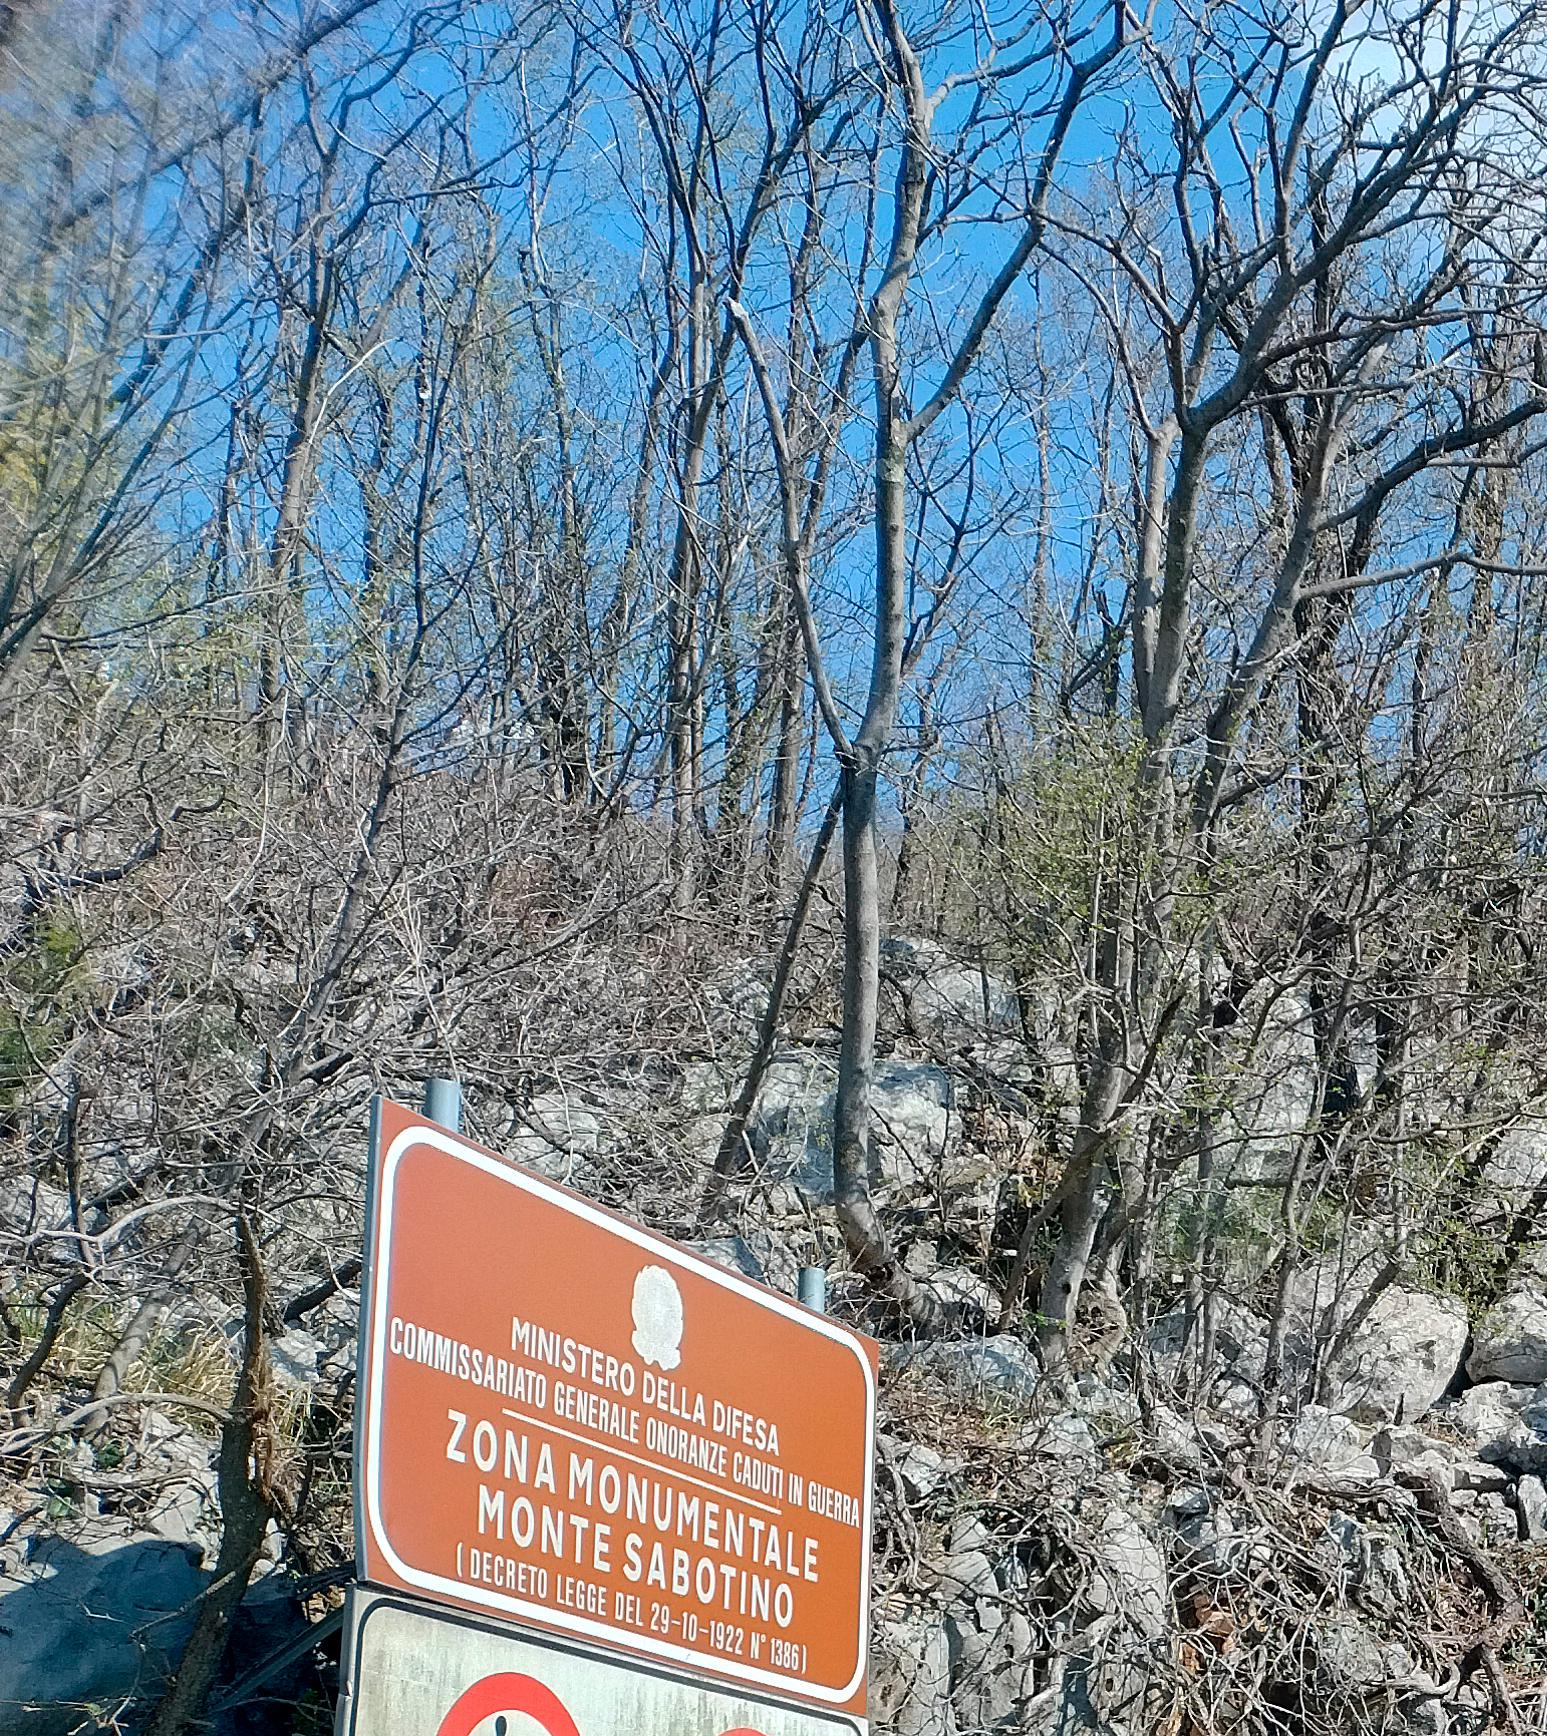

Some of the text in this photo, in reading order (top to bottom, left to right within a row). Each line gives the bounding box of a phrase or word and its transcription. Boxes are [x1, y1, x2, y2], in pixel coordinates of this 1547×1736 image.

[390, 1316, 861, 1528] COMMISSARIATO GENERALE ONORANZE CADUTI IN GUERRA
[511, 1316, 780, 1457] MINISTERO DELLA DIFESA
[445, 1409, 819, 1582] ZONA MONUMENTALE
[478, 1485, 794, 1629] MONTE SABOTINO
[556, 1577, 608, 1617] LEGGE
[615, 1592, 644, 1628] DEL
[650, 1604, 744, 1656] 29-10-1922
[750, 1632, 767, 1661] N°
